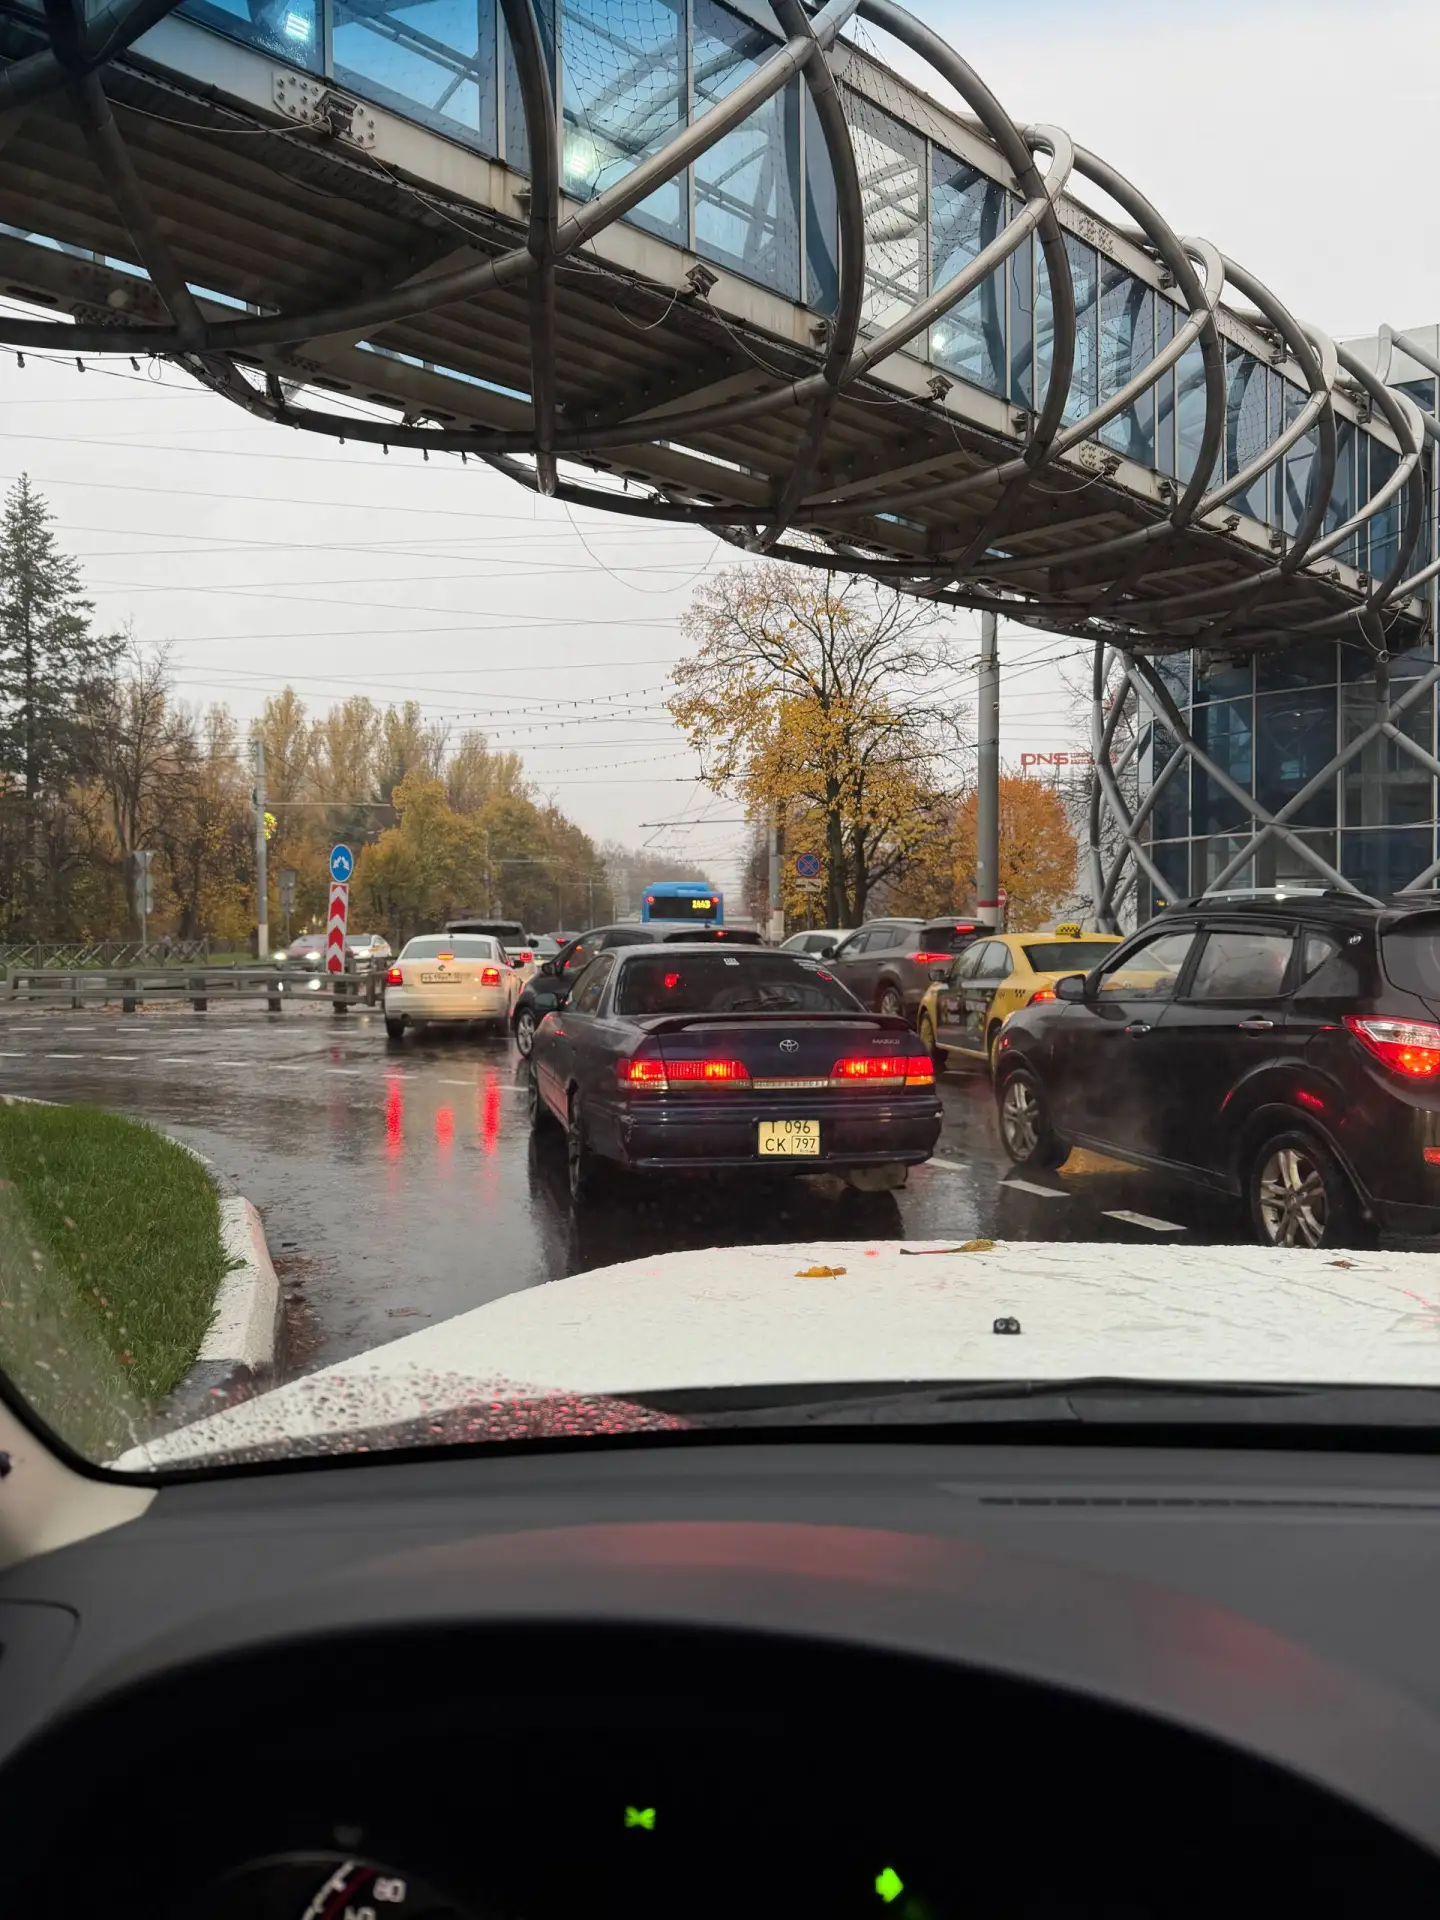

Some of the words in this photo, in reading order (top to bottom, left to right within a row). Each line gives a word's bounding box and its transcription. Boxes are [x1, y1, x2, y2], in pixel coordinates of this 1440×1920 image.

[1021, 753, 1068, 765] DNS
[785, 1120, 811, 1134] 096
[795, 1138, 815, 1149] 797
